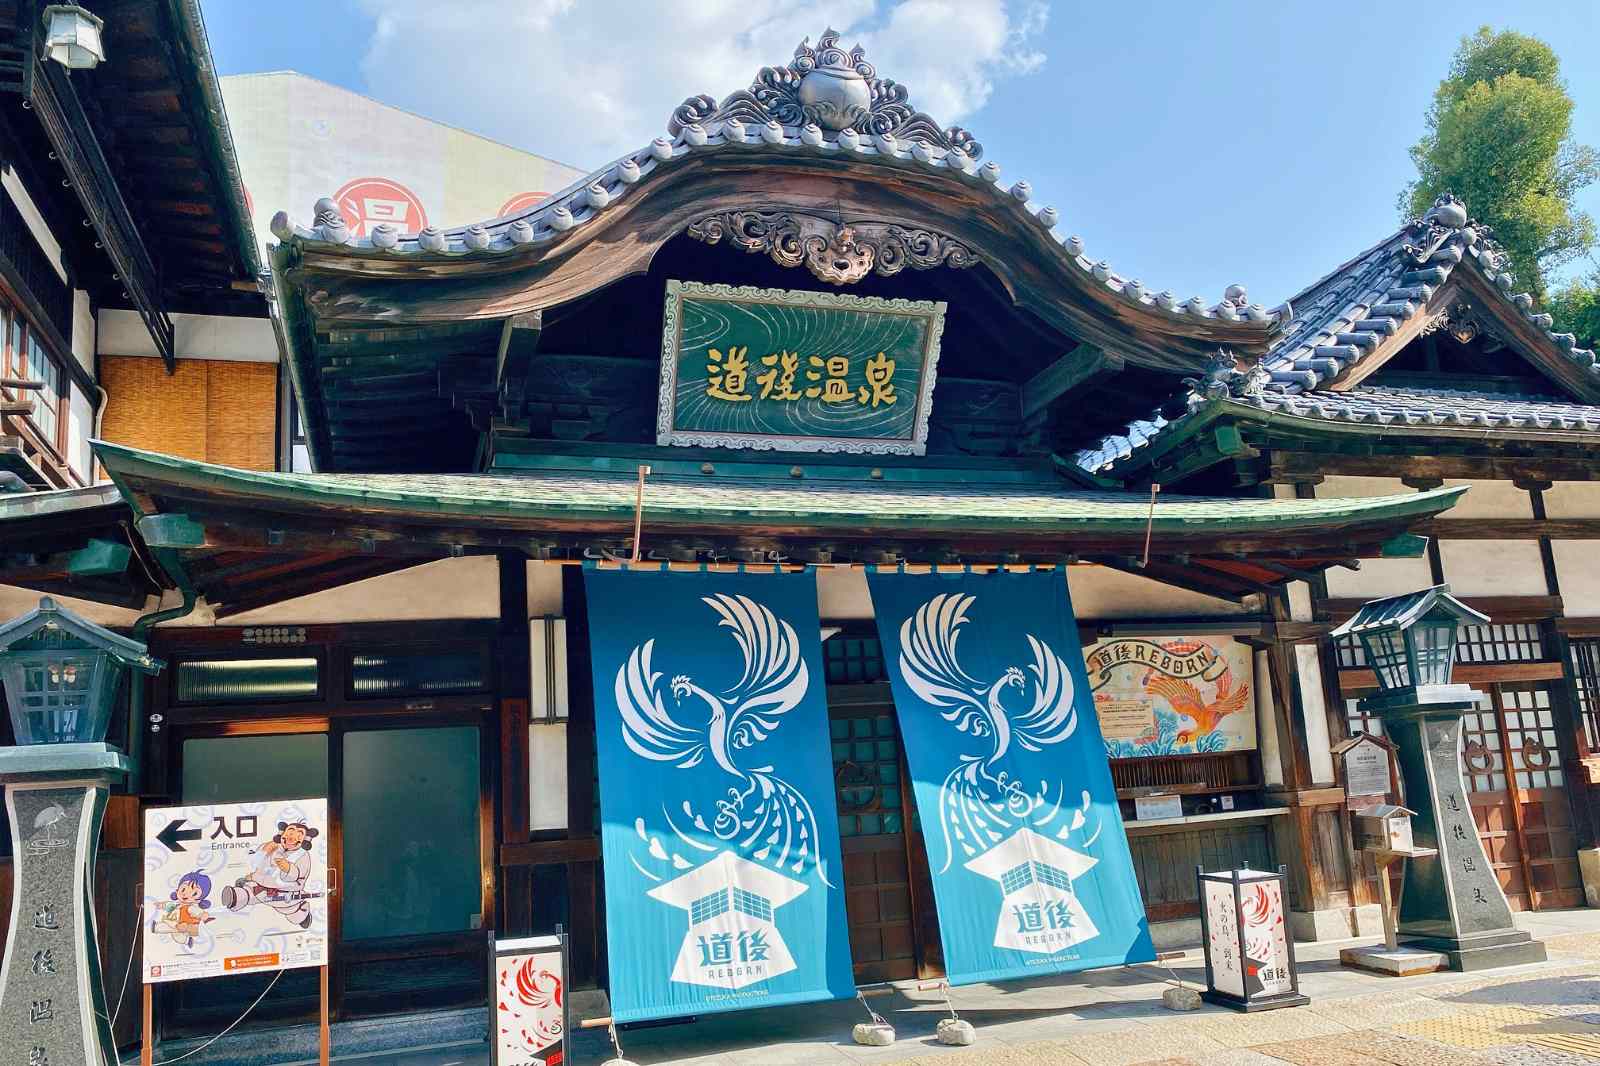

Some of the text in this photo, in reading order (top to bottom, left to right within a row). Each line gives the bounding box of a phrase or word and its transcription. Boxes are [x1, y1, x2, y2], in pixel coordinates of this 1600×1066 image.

[706, 346, 898, 408] 道後温泉
[210, 815, 258, 839] 入口
[211, 841, 251, 851] Entrance
[1012, 897, 1076, 933] 道後
[696, 928, 771, 967] 道後
[708, 965, 763, 979] REBORN
[1263, 967, 1287, 981] 道後
